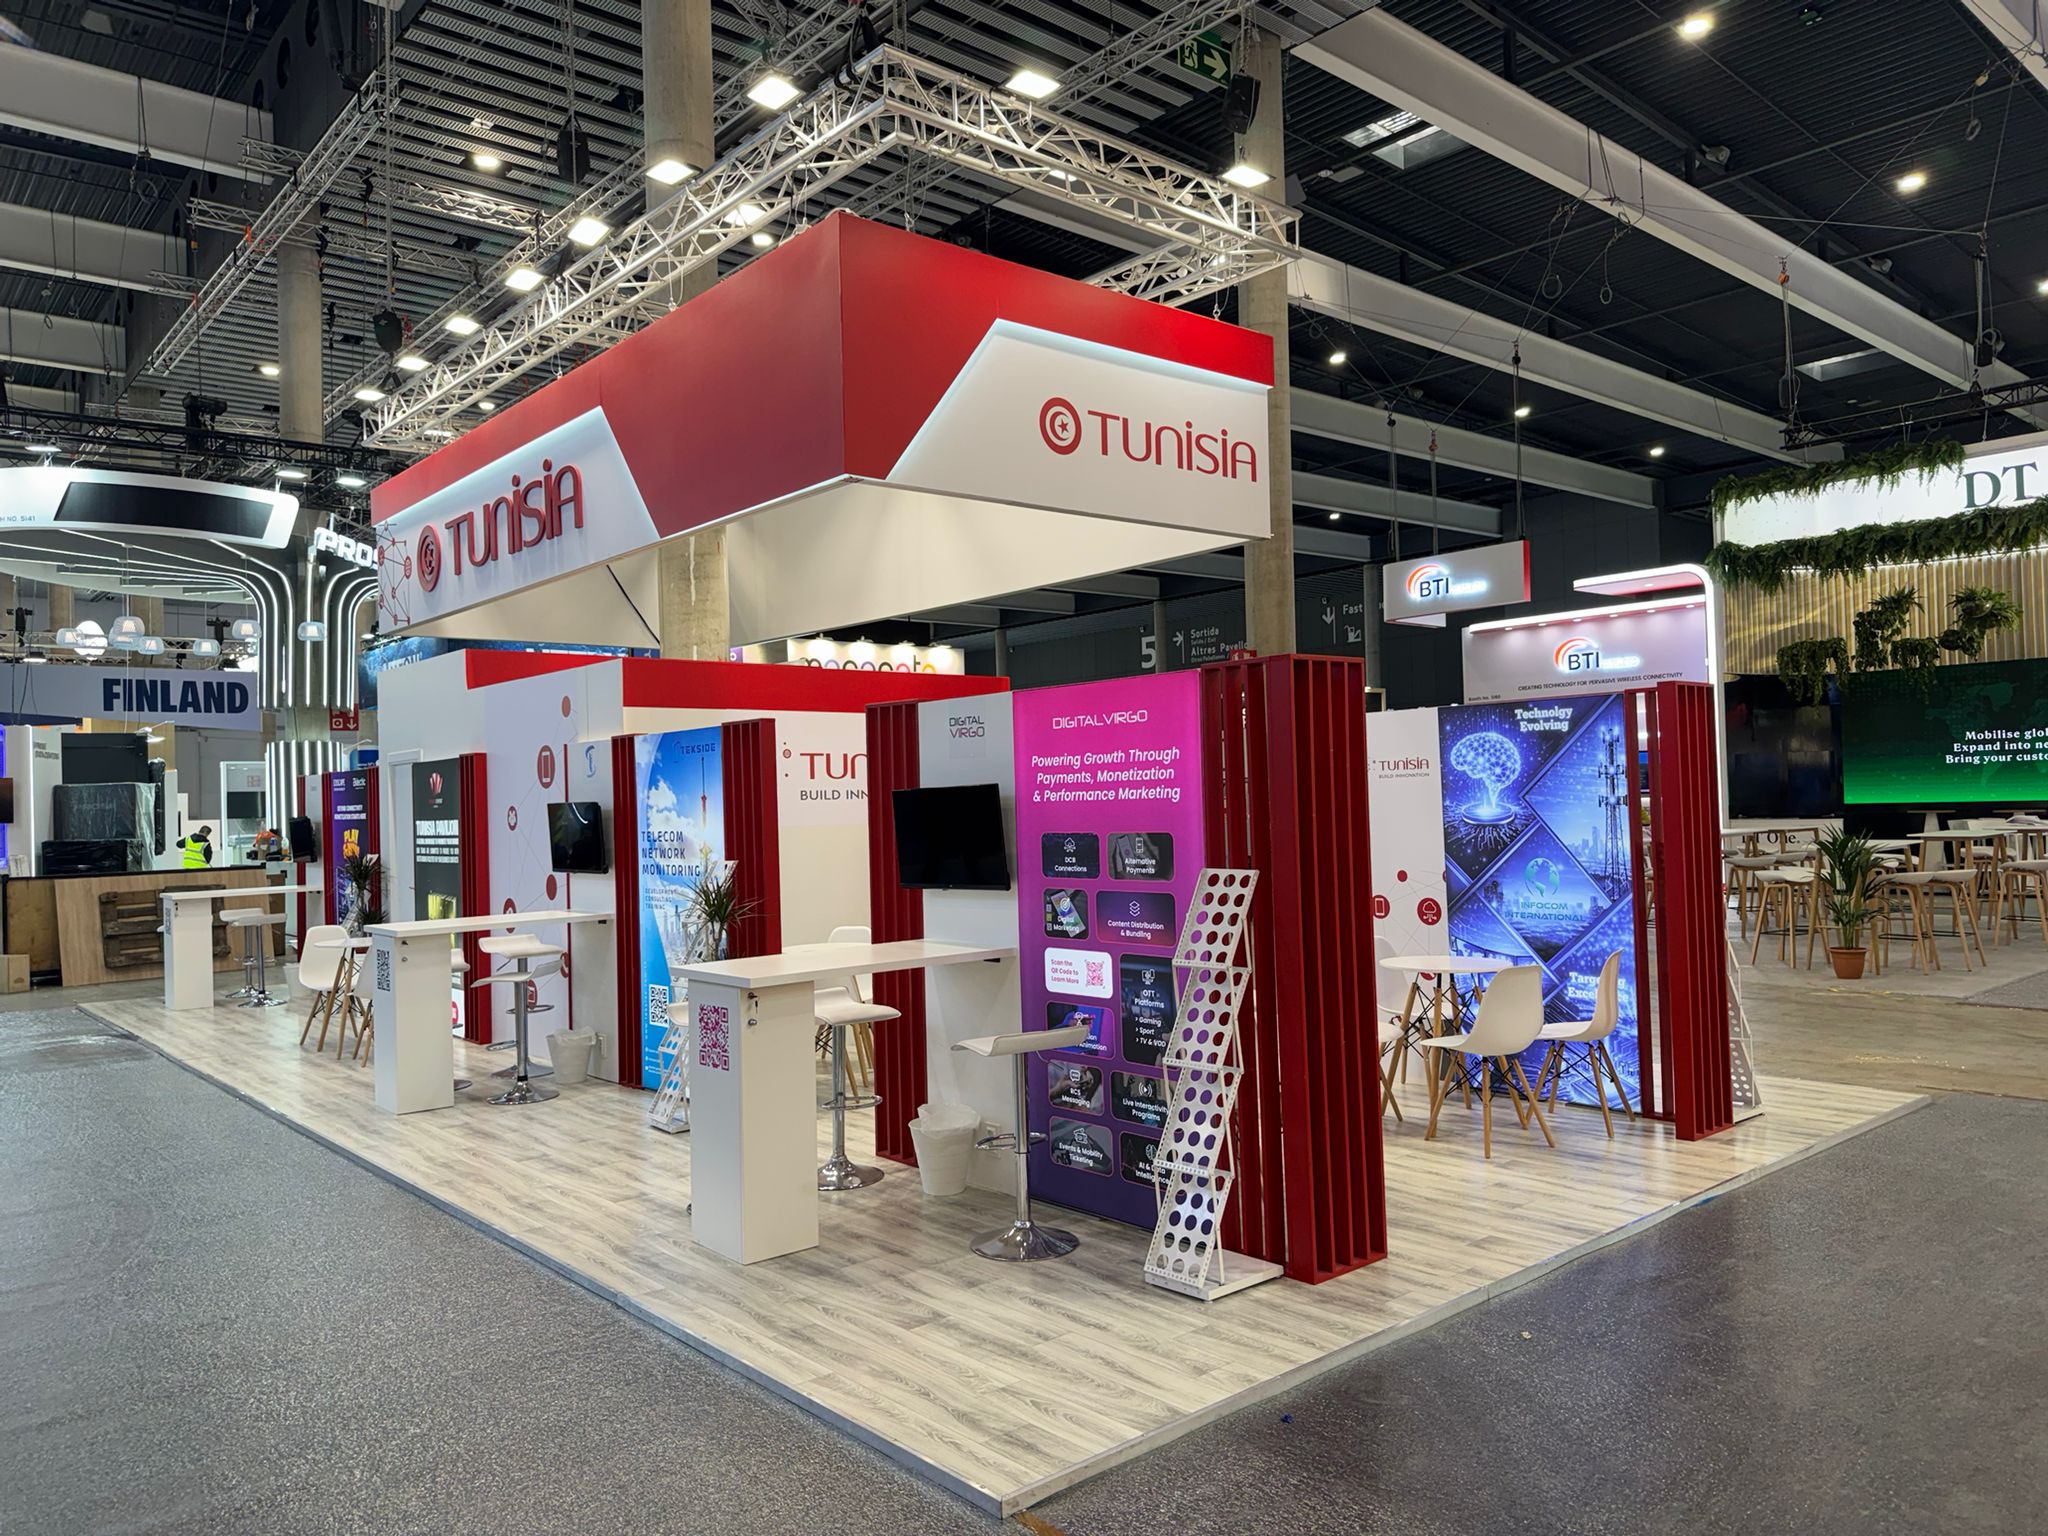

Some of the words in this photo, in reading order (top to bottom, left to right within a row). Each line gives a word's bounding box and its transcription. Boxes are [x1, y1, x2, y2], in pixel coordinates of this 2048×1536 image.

[1420, 577, 1449, 597] BTI
[1190, 626, 1219, 639] Sortida
[1140, 635, 1156, 668] 5
[1191, 646, 1217, 657] Altres
[1568, 651, 1599, 671] BTI
[102, 678, 249, 714] FINLAND
[1514, 706, 1573, 723] Technolgy
[949, 714, 985, 728] DIGITAL
[1519, 718, 1569, 732] Evolving
[949, 726, 985, 739] VIRGO
[1965, 729, 2021, 741] Mobilise
[1953, 741, 2000, 754] Expand
[2004, 741, 2031, 751] into
[1031, 753, 1081, 769] Powering
[1083, 750, 1125, 766] Growth
[1128, 747, 1180, 764] Through
[1945, 754, 1981, 765] Bring
[1983, 754, 2013, 765] your
[1036, 770, 1095, 787] Payments,
[1097, 766, 1175, 783] Monetization
[800, 789, 841, 801] BUILD
[1032, 791, 1041, 802] &
[1044, 787, 1115, 803] Performance
[1118, 785, 1181, 803] Marketing
[641, 831, 684, 843] TELECOM
[641, 848, 686, 859] NETWORK
[642, 864, 701, 877] MONITORING
[1054, 864, 1087, 873] Connections
[1126, 866, 1155, 875] Payments
[1521, 902, 1568, 911] INFOCOM
[1504, 911, 1586, 922] INTERNATIONAL
[1107, 920, 1131, 929] Content
[1131, 921, 1165, 931] Distribution
[1126, 930, 1152, 940] Bundling
[1134, 998, 1165, 1009] Platforms
[1139, 1016, 1162, 1027] Gaming
[1139, 1026, 1155, 1035] Sport
[1061, 1096, 1091, 1107] Messaging
[1122, 1098, 1134, 1106] Live
[1131, 1109, 1161, 1121] Programs
